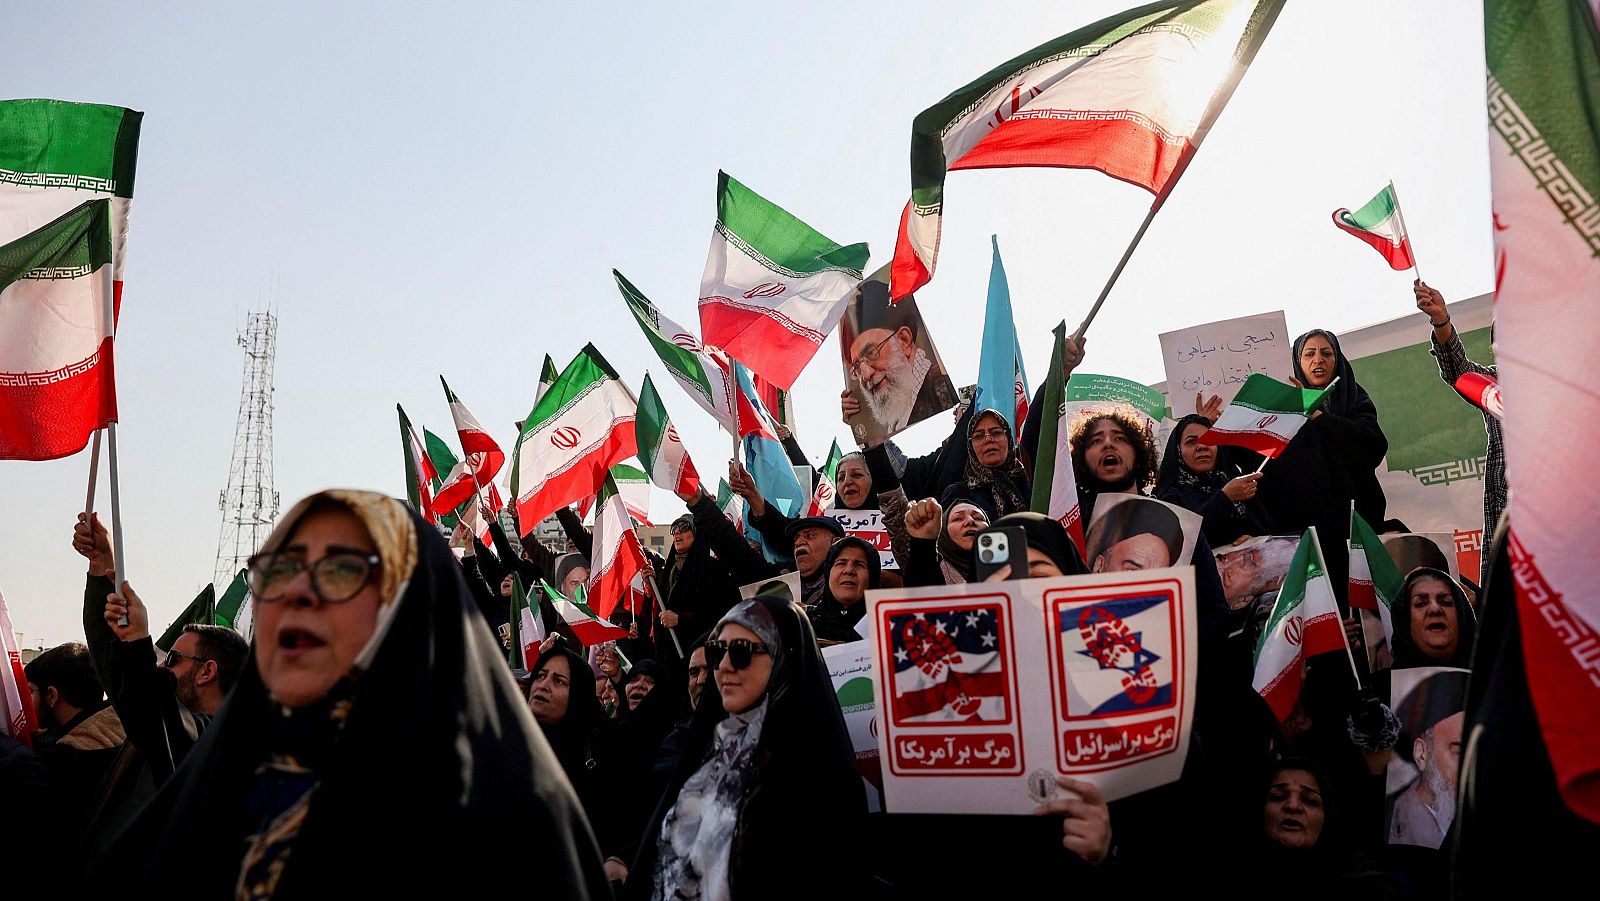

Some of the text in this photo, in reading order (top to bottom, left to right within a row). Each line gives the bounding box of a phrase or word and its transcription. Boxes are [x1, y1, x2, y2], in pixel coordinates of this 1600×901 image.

[899, 737, 1011, 766] مرگ بر آمریکا
[1066, 723, 1174, 762] مرگ بر اسرائیل
